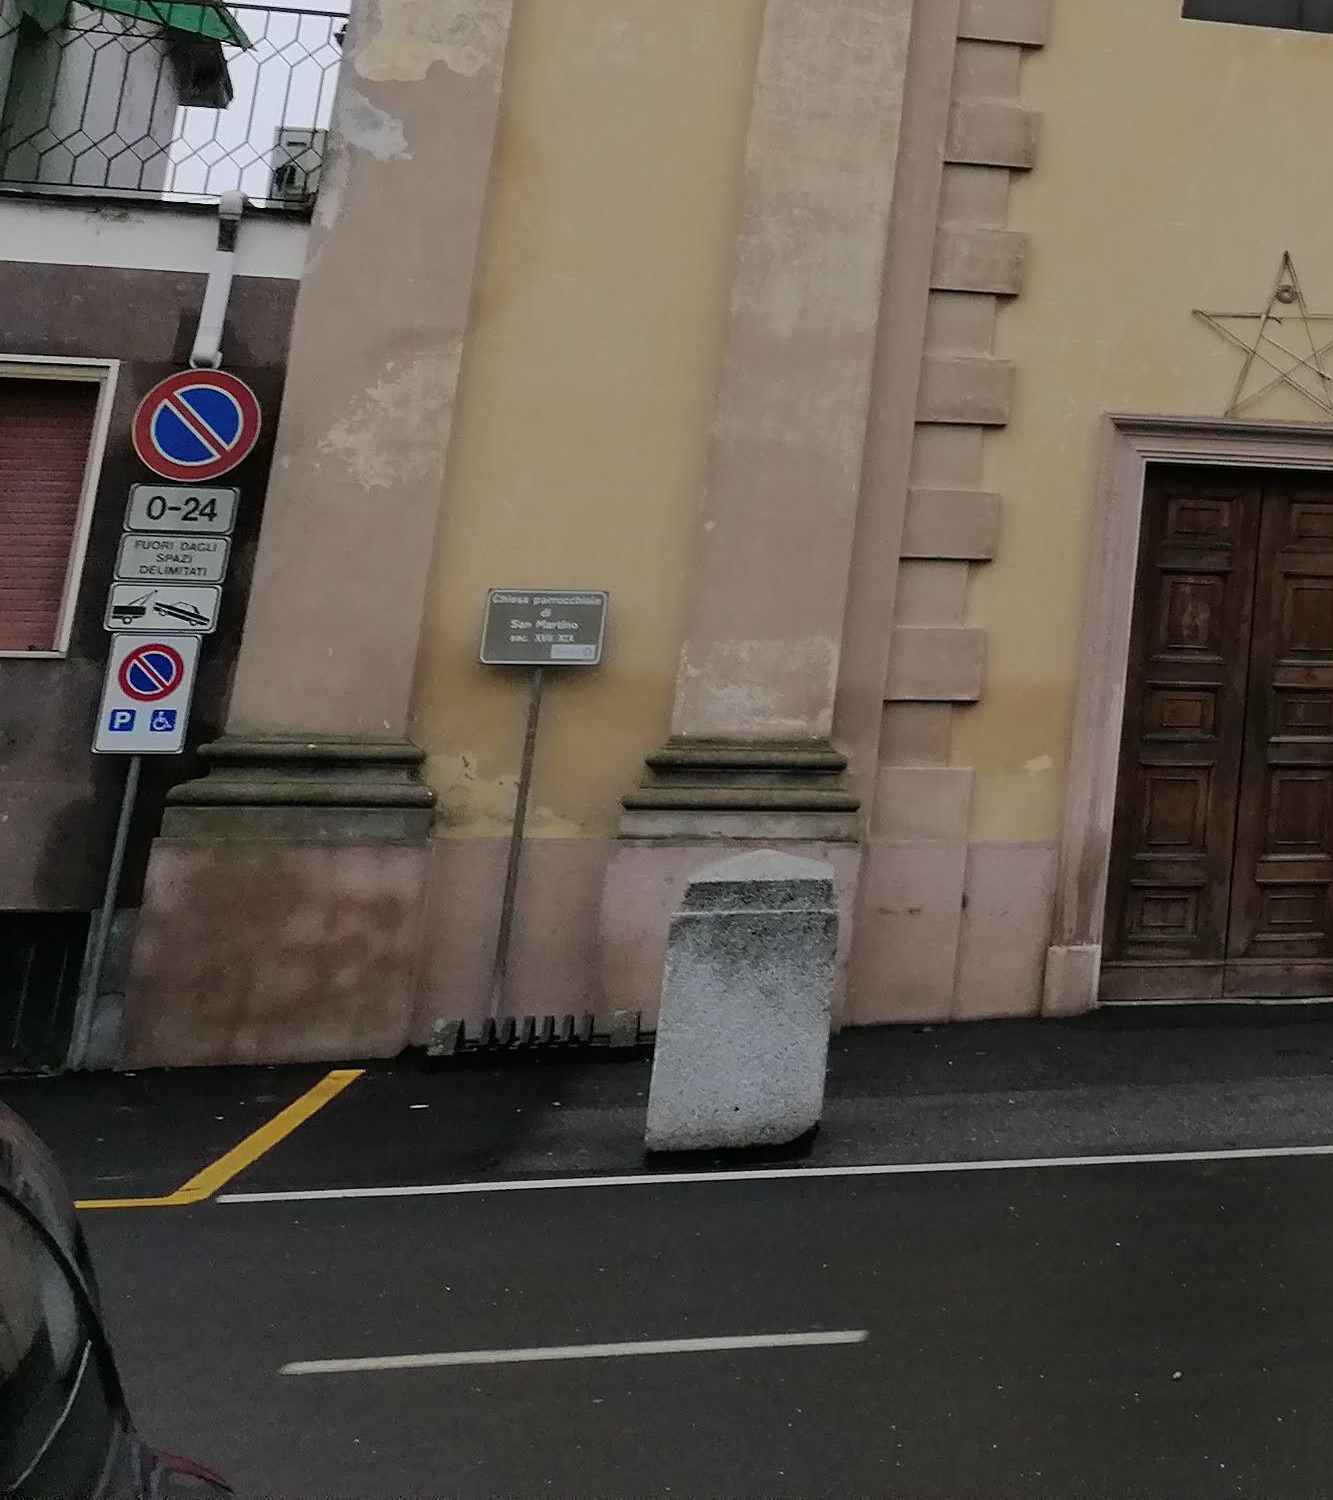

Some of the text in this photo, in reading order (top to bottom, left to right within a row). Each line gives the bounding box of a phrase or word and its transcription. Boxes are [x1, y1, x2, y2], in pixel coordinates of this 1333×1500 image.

[146, 495, 217, 521] 0-24
[134, 540, 218, 552] FUORI DAGLI
[155, 553, 193, 564] SPAZI
[139, 565, 208, 576] DELIMITATI
